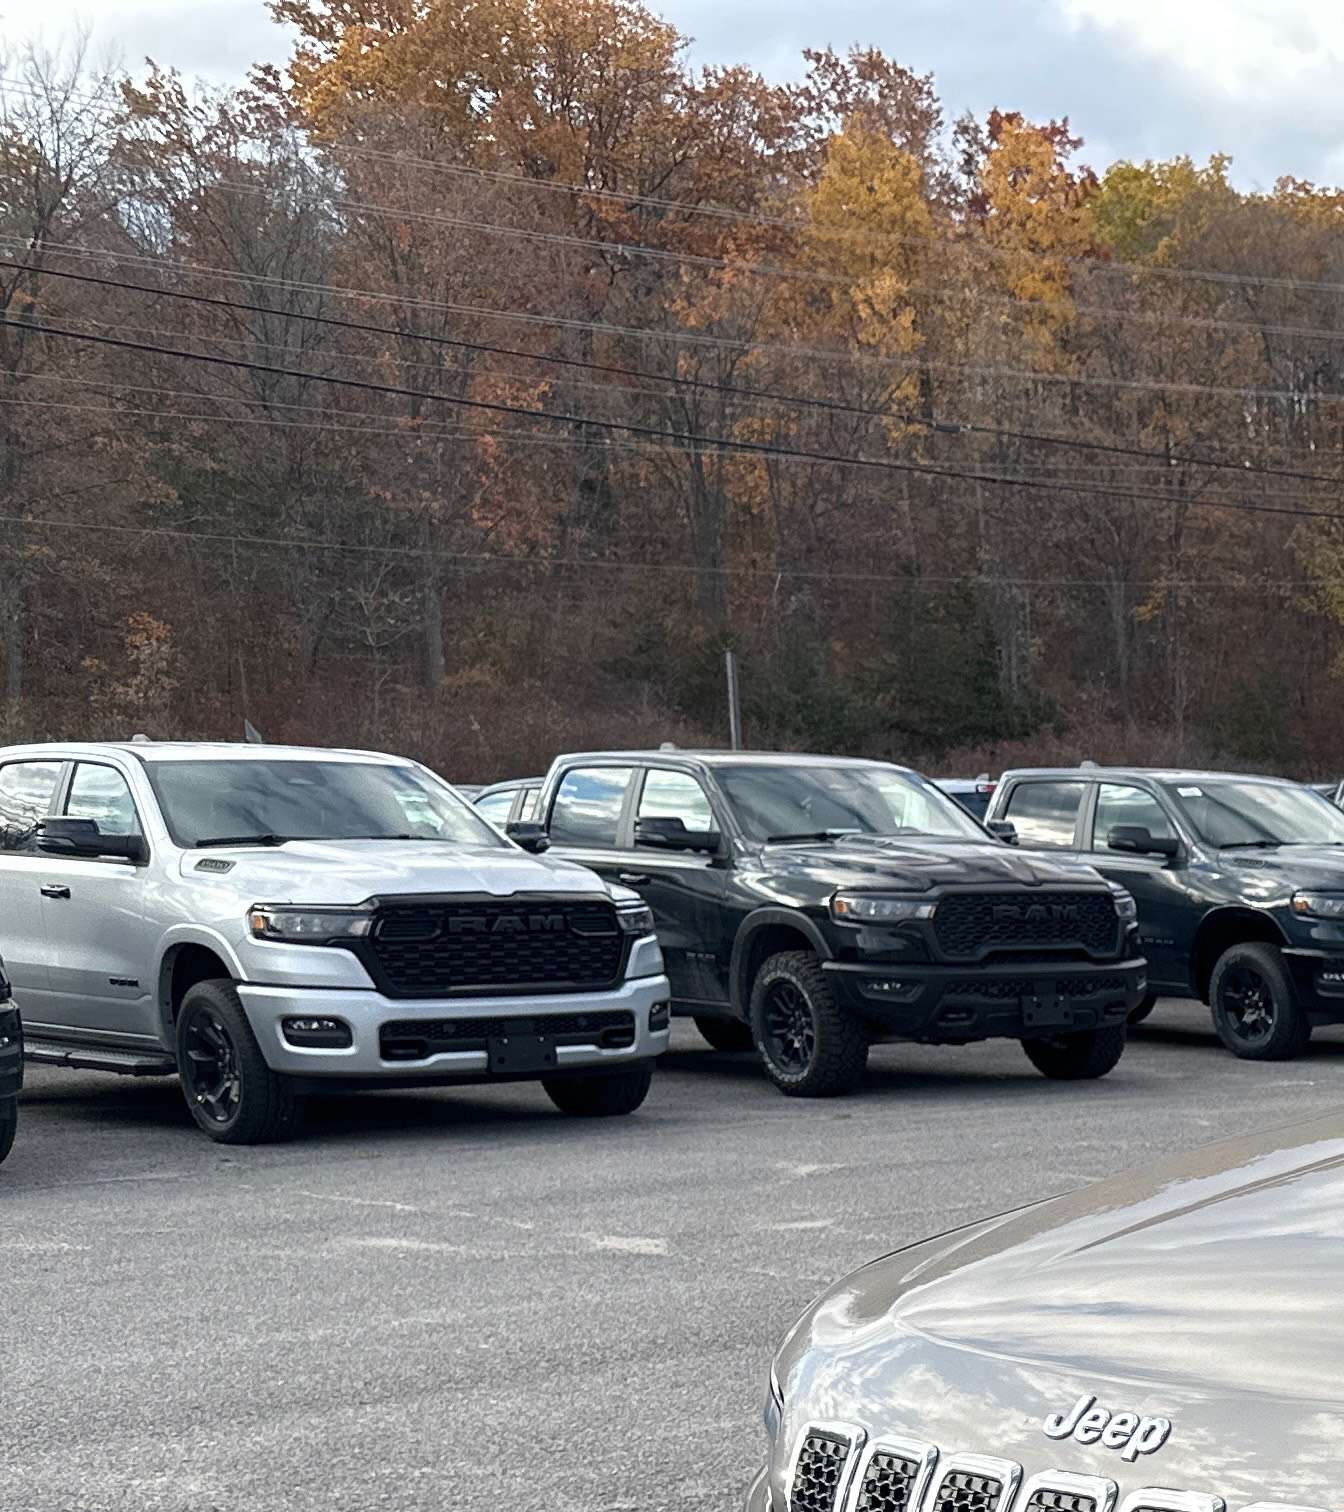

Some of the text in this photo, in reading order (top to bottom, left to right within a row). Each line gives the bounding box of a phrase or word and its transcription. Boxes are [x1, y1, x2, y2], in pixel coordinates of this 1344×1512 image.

[992, 904, 1078, 921] RAM
[449, 915, 563, 931] RAM
[1043, 1394, 1172, 1462] Jeep
